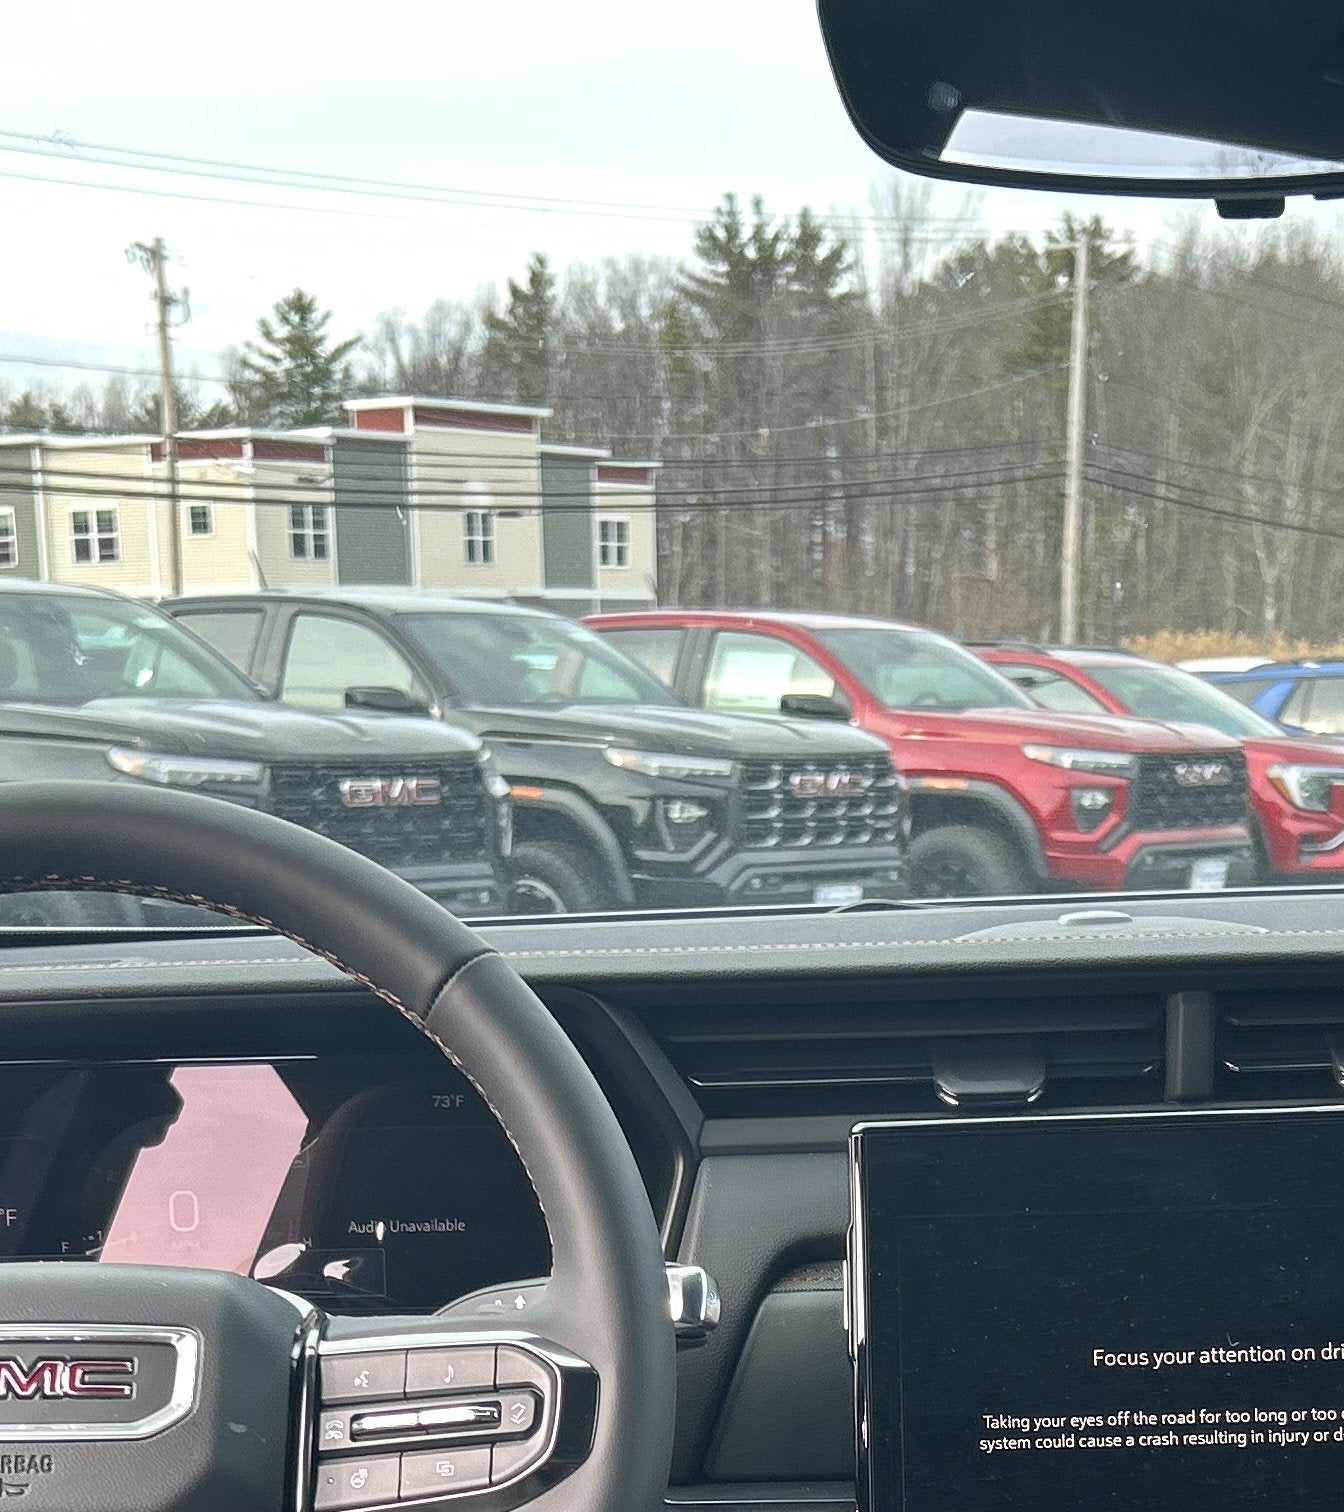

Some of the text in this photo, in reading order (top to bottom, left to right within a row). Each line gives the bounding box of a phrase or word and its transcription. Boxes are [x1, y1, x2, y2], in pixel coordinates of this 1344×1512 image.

[339, 778, 441, 808] GMC
[168, 1190, 199, 1232] 0
[390, 1218, 466, 1233] Unavailable
[1093, 1349, 1149, 1366] Focus
[1153, 1350, 1196, 1370] your
[1199, 1346, 1286, 1364] attention
[1291, 1348, 1316, 1361] on
[983, 1414, 1030, 1432] Taking
[1034, 1416, 1067, 1434] your
[1070, 1414, 1104, 1431] eyes
[1107, 1410, 1131, 1427] off
[1133, 1410, 1157, 1426] the
[1161, 1409, 1196, 1425] road
[1199, 1408, 1222, 1424] for
[1225, 1409, 1251, 1423] too
[1254, 1407, 1288, 1426] long
[1291, 1409, 1308, 1422] or
[1311, 1407, 1337, 1421] too
[979, 1437, 1031, 1454] system
[1035, 1433, 1075, 1449] could
[1078, 1435, 1122, 1448] cause
[1125, 1435, 1135, 1447] a
[1138, 1431, 1179, 1447] crash
[1183, 1429, 1247, 1448] resulting
[1251, 1429, 1264, 1444] in
[1268, 1429, 1309, 1447] injury
[1313, 1429, 1330, 1442] or
